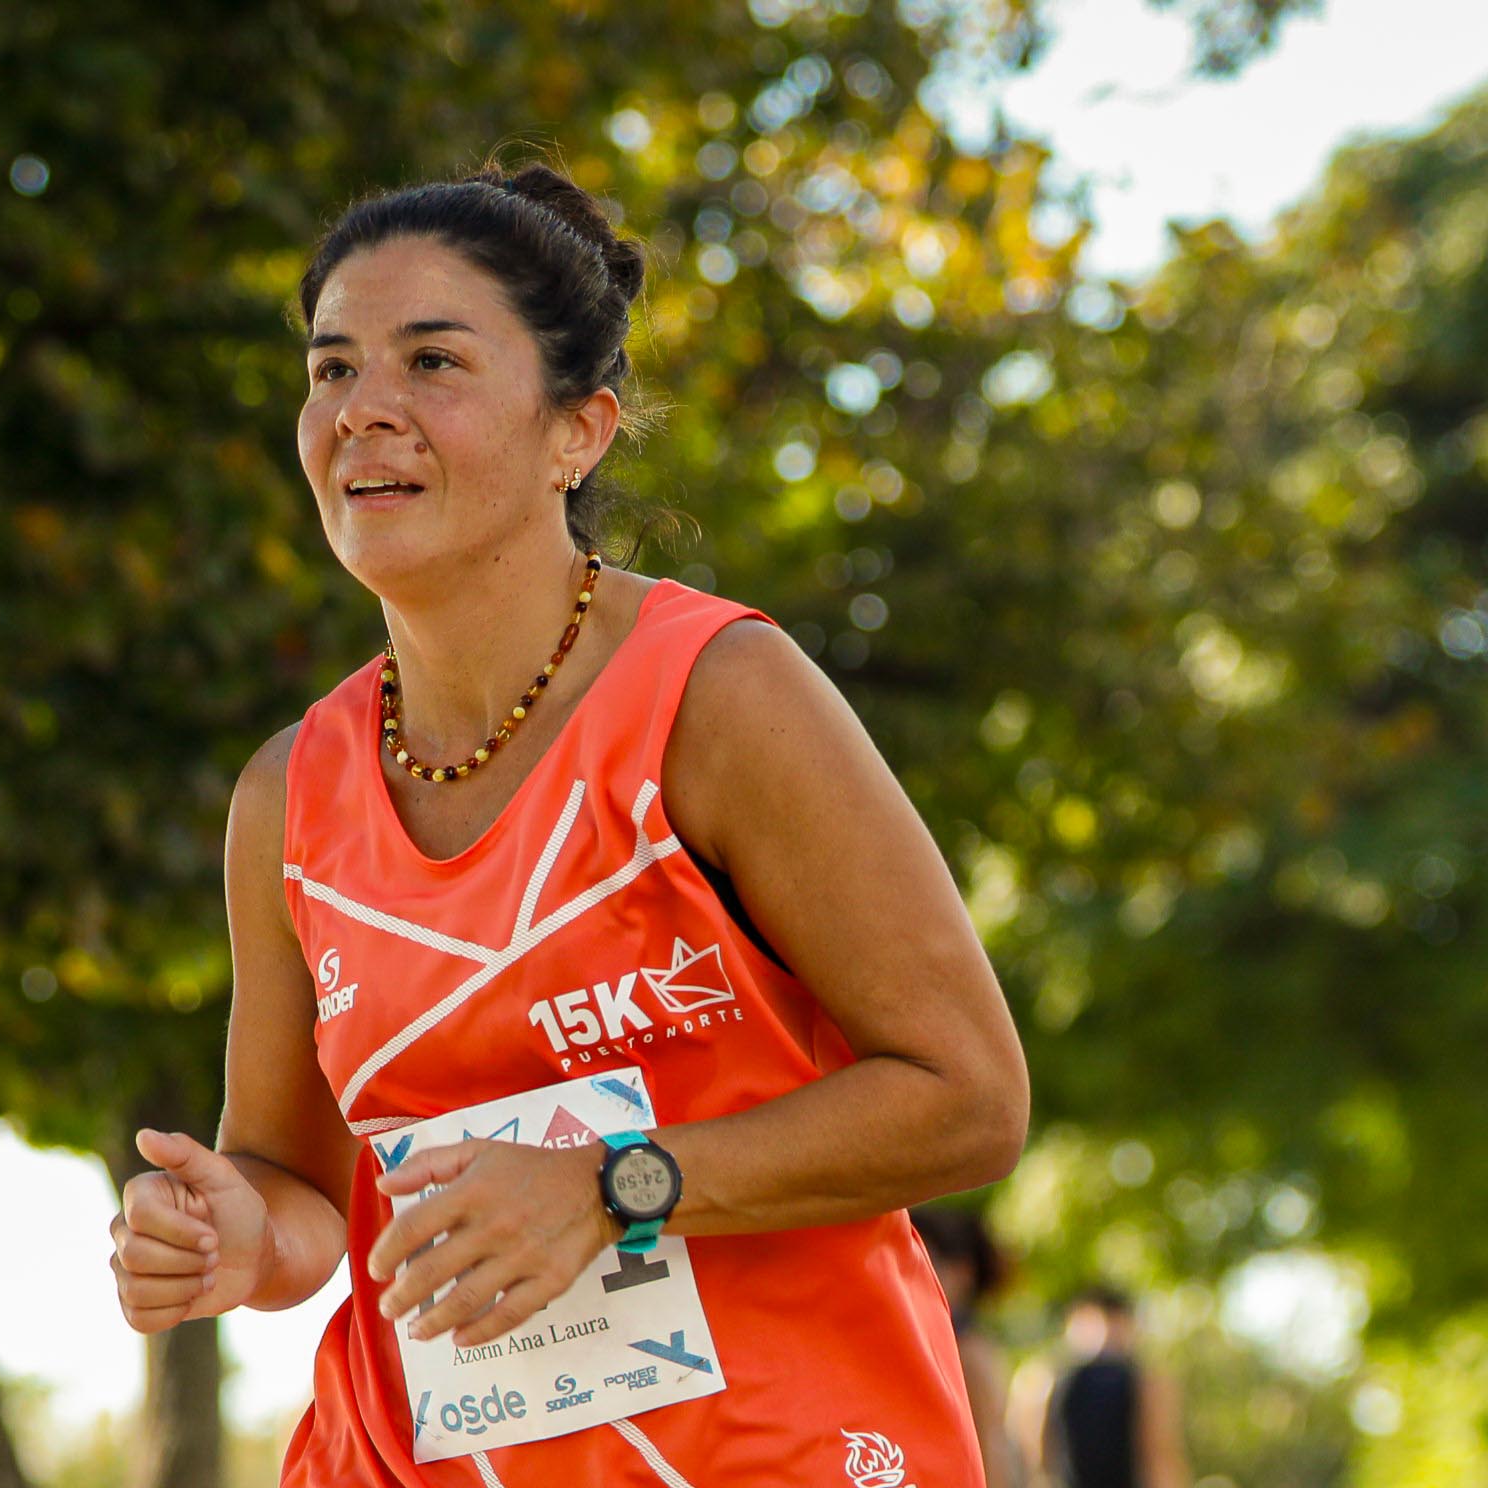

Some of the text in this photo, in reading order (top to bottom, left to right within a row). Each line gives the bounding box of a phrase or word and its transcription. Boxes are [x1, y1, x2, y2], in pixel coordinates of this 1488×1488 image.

[528, 971, 653, 1053] 15K
[666, 1008, 743, 1038] NORTE
[508, 1335, 545, 1355] Ana
[548, 1316, 610, 1344] Laura
[603, 1366, 657, 1387] POWER
[440, 1384, 527, 1435] osde
